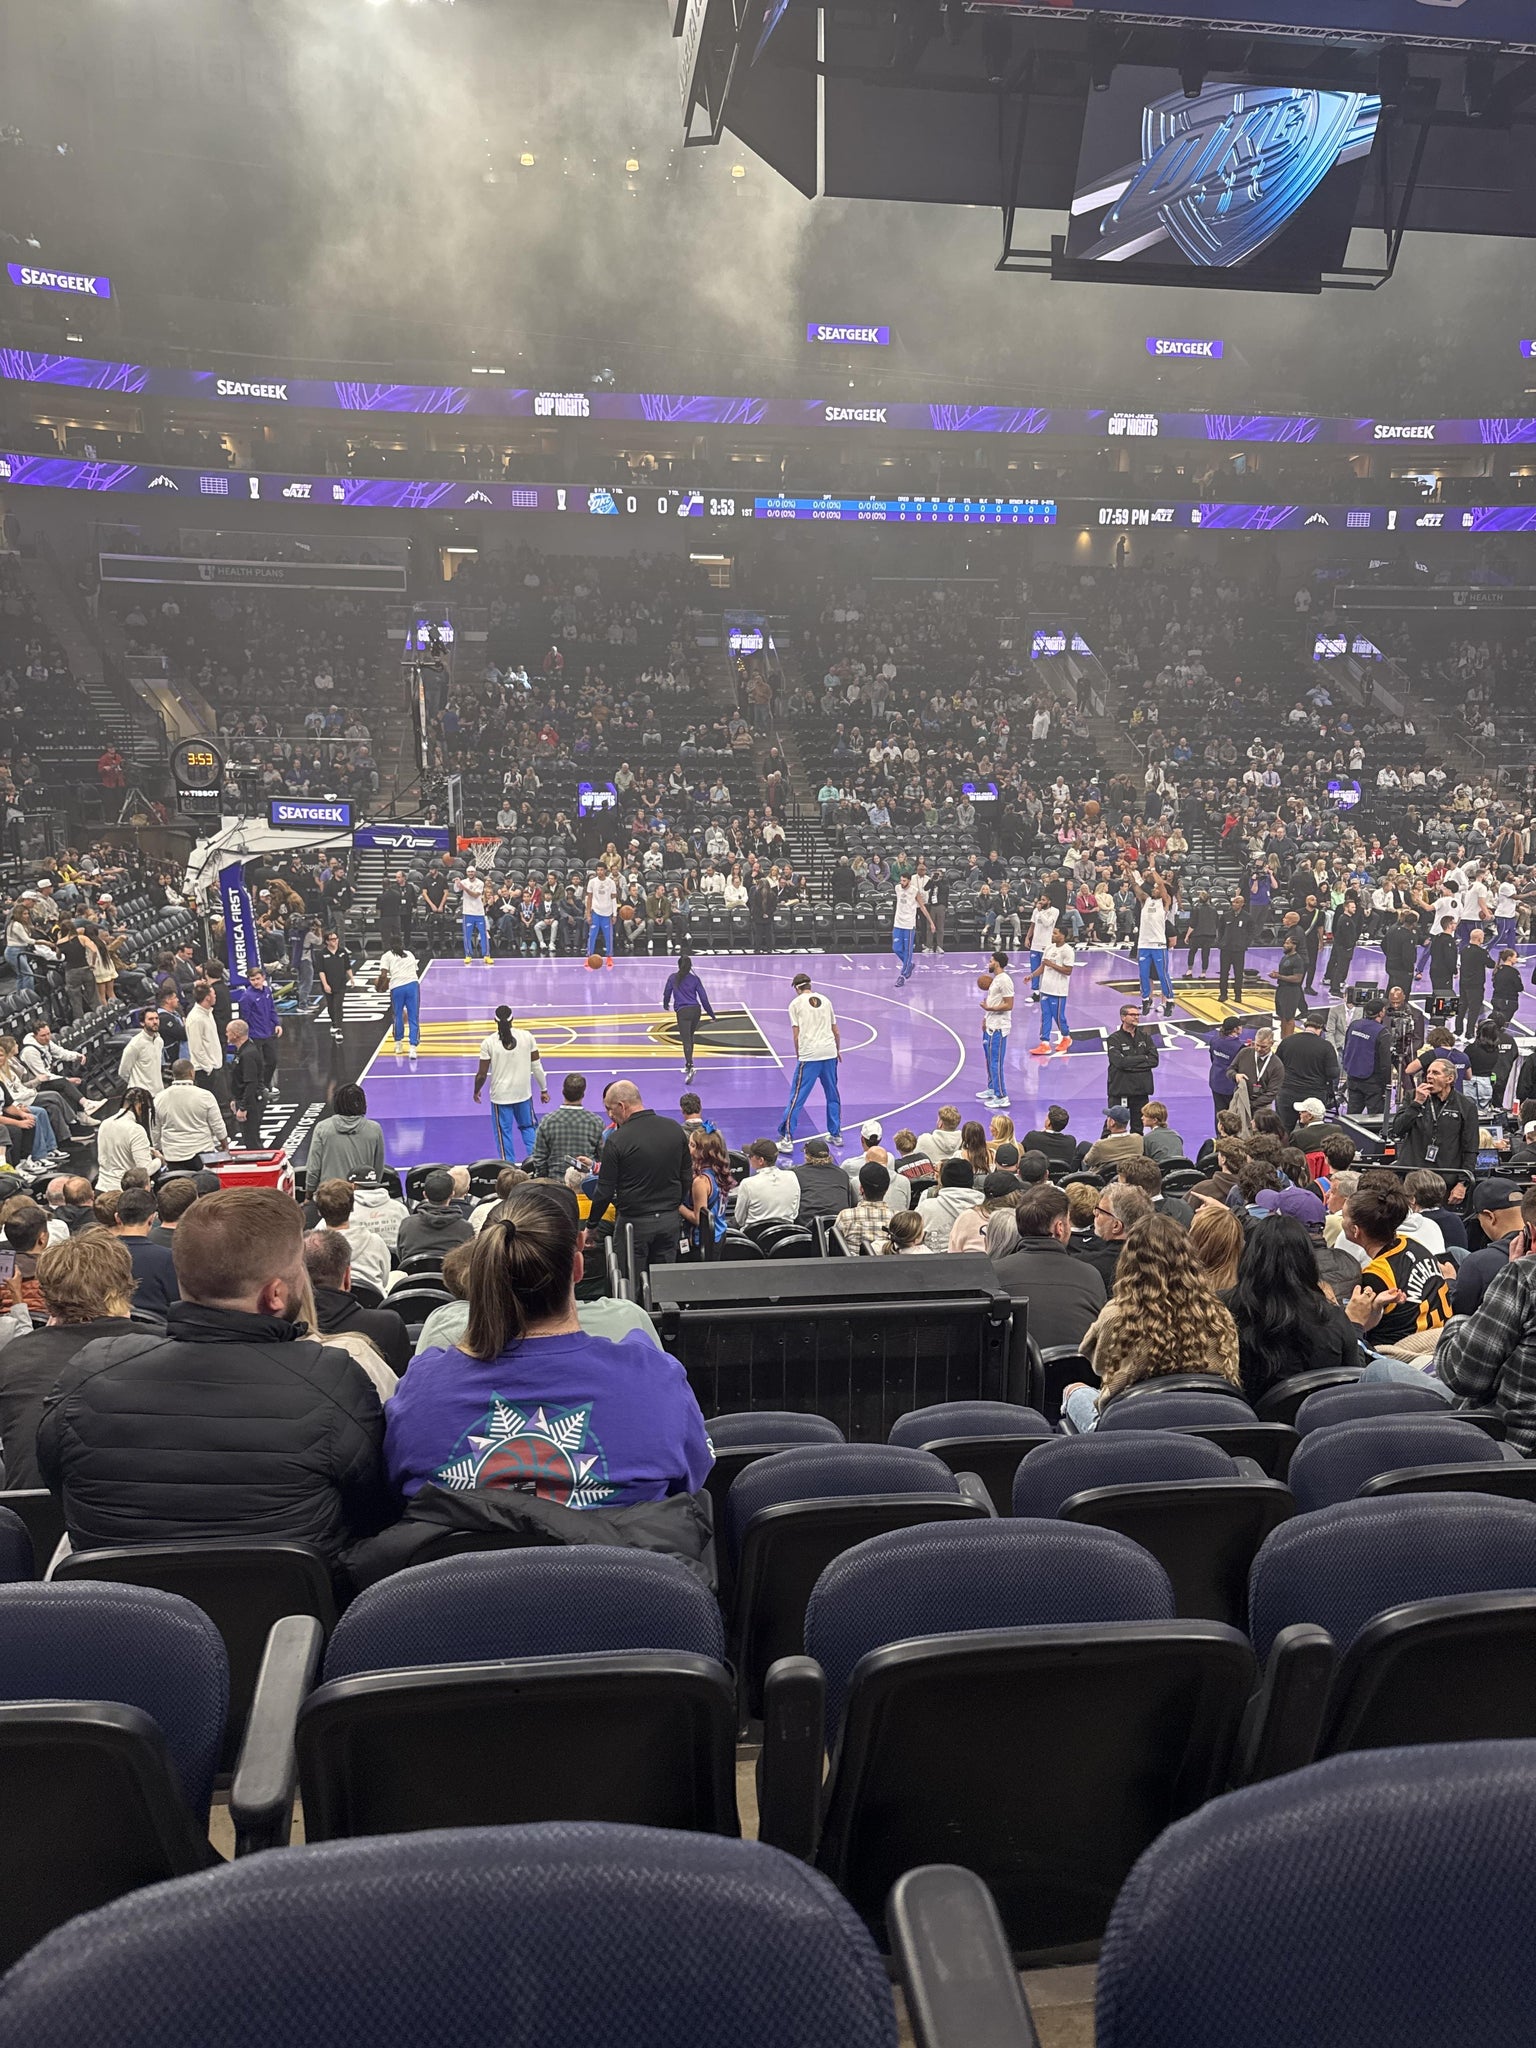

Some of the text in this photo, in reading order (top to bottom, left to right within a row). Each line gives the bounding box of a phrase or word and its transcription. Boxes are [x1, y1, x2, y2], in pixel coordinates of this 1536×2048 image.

[20, 267, 98, 295] SEATGEEK
[817, 326, 879, 343] SEATGEEK
[1155, 340, 1213, 357] SEATGEEK
[216, 379, 288, 400] SEATGEEK
[534, 397, 590, 417] CUP NIGHTS
[825, 407, 887, 424] SEATGEEK
[1108, 417, 1158, 436] CUP NIGHTS
[1373, 424, 1435, 440] SEATGEEK
[626, 496, 637, 513] 0
[657, 497, 668, 514] 0
[709, 498, 735, 516] 3:53
[741, 508, 753, 517] 1ST
[767, 500, 781, 508] 0/0
[781, 500, 796, 509] (0%)
[813, 501, 826, 509] 0/0
[826, 501, 841, 510] (0%)
[859, 502, 871, 510] 0/0
[872, 502, 886, 511] (0%)
[767, 509, 780, 517] 0/0
[781, 509, 796, 518] (0%)
[812, 510, 826, 518] 0/0
[826, 510, 841, 519] (0%)
[858, 511, 871, 519] 0/0
[872, 512, 886, 520] (0%)
[1098, 508, 1150, 525] 07:59 PM
[217, 567, 253, 576] HEALTH
[255, 568, 285, 578] PLANS
[1470, 593, 1504, 601] HEALTH
[187, 752, 213, 766] 3:53
[278, 805, 343, 822] SEATGEEK
[228, 887, 248, 978] AMERICA FIRST
[304, 1102, 326, 1117] UTAH
[297, 1117, 316, 1126] OF
